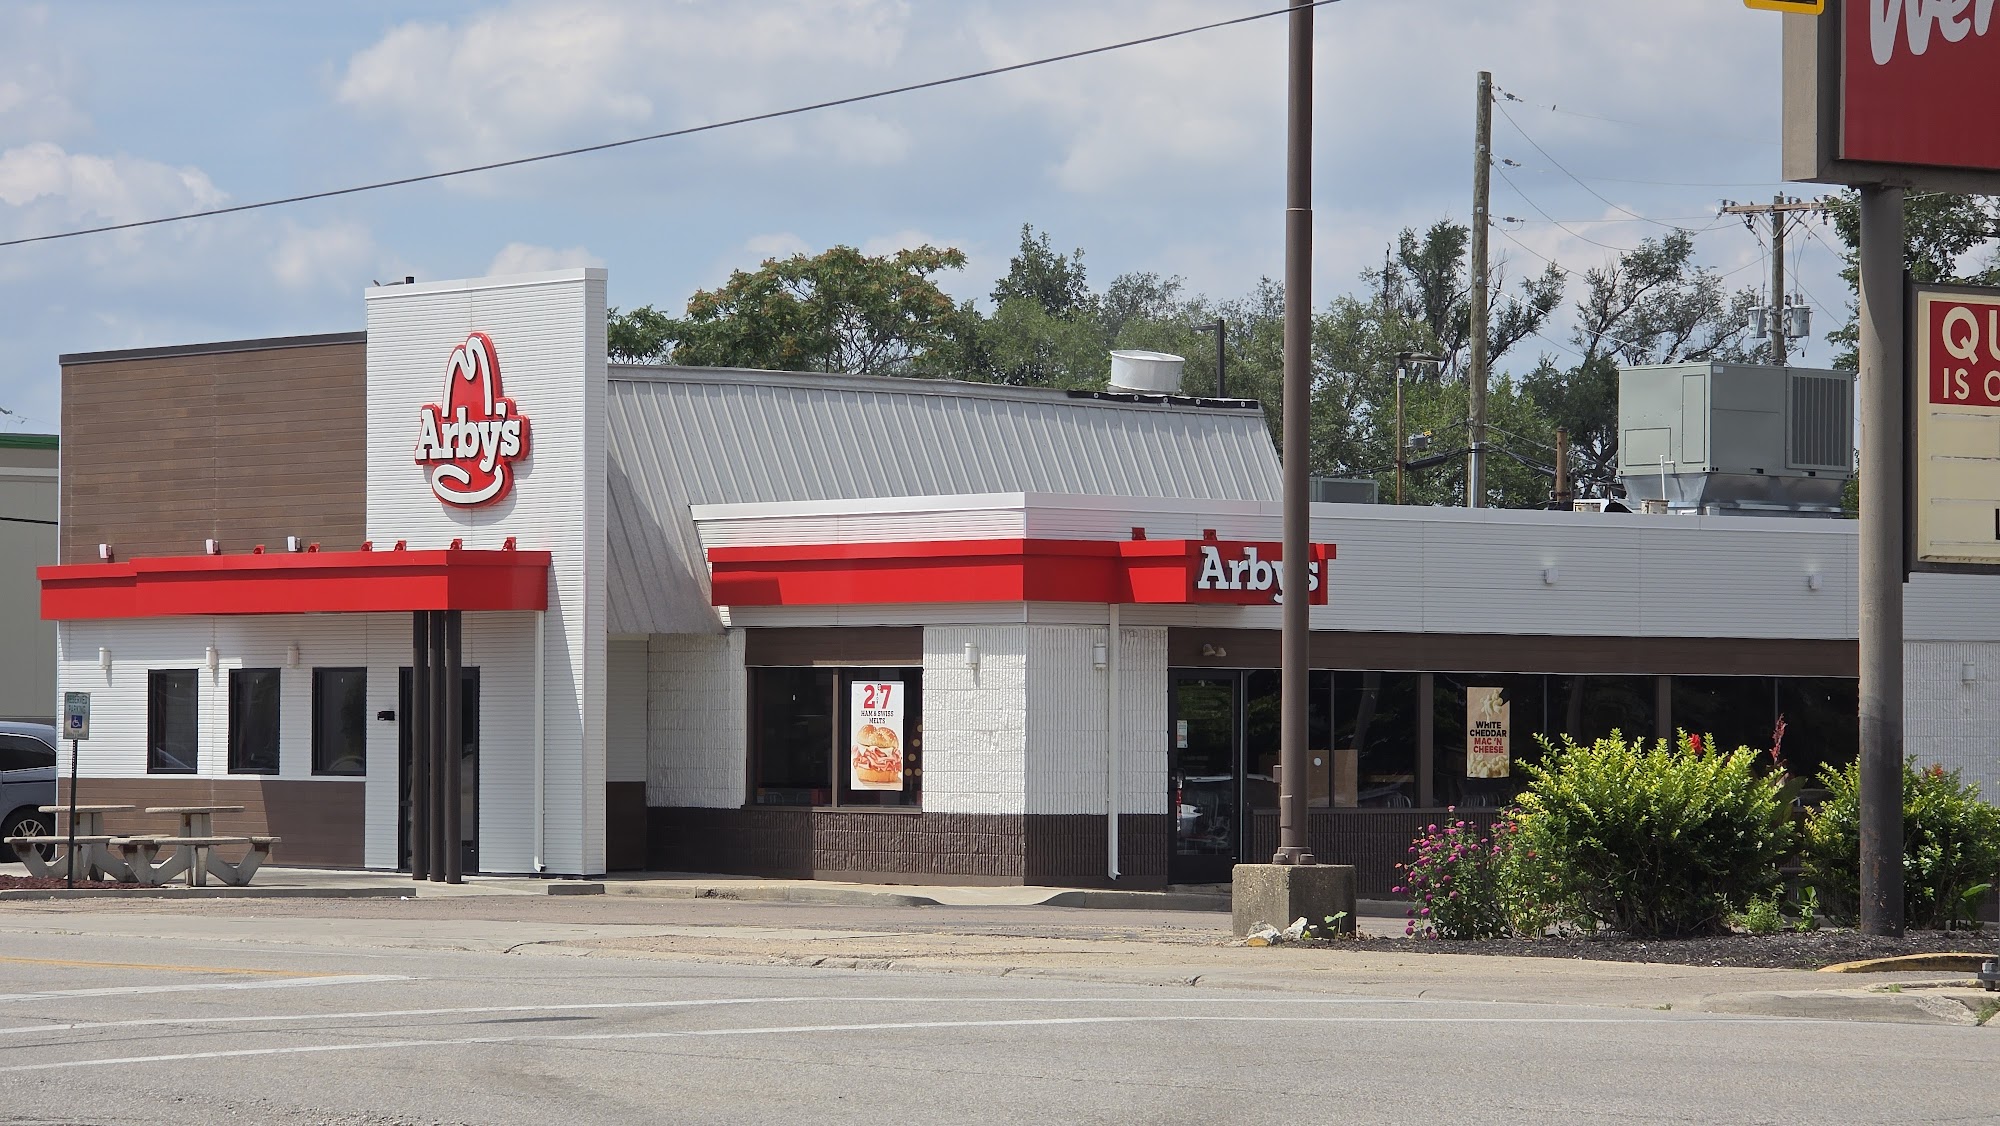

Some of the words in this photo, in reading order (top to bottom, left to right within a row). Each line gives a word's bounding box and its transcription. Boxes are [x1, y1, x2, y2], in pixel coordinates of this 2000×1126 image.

[1869, 0, 1994, 65] We
[1943, 368, 1969, 400] IS
[415, 402, 520, 473] Arby's
[1475, 721, 1502, 729] WHITE
[1469, 729, 1507, 737] CHEDDAR
[1474, 737, 1492, 745] MAC
[1473, 745, 1504, 753] CHEESE
